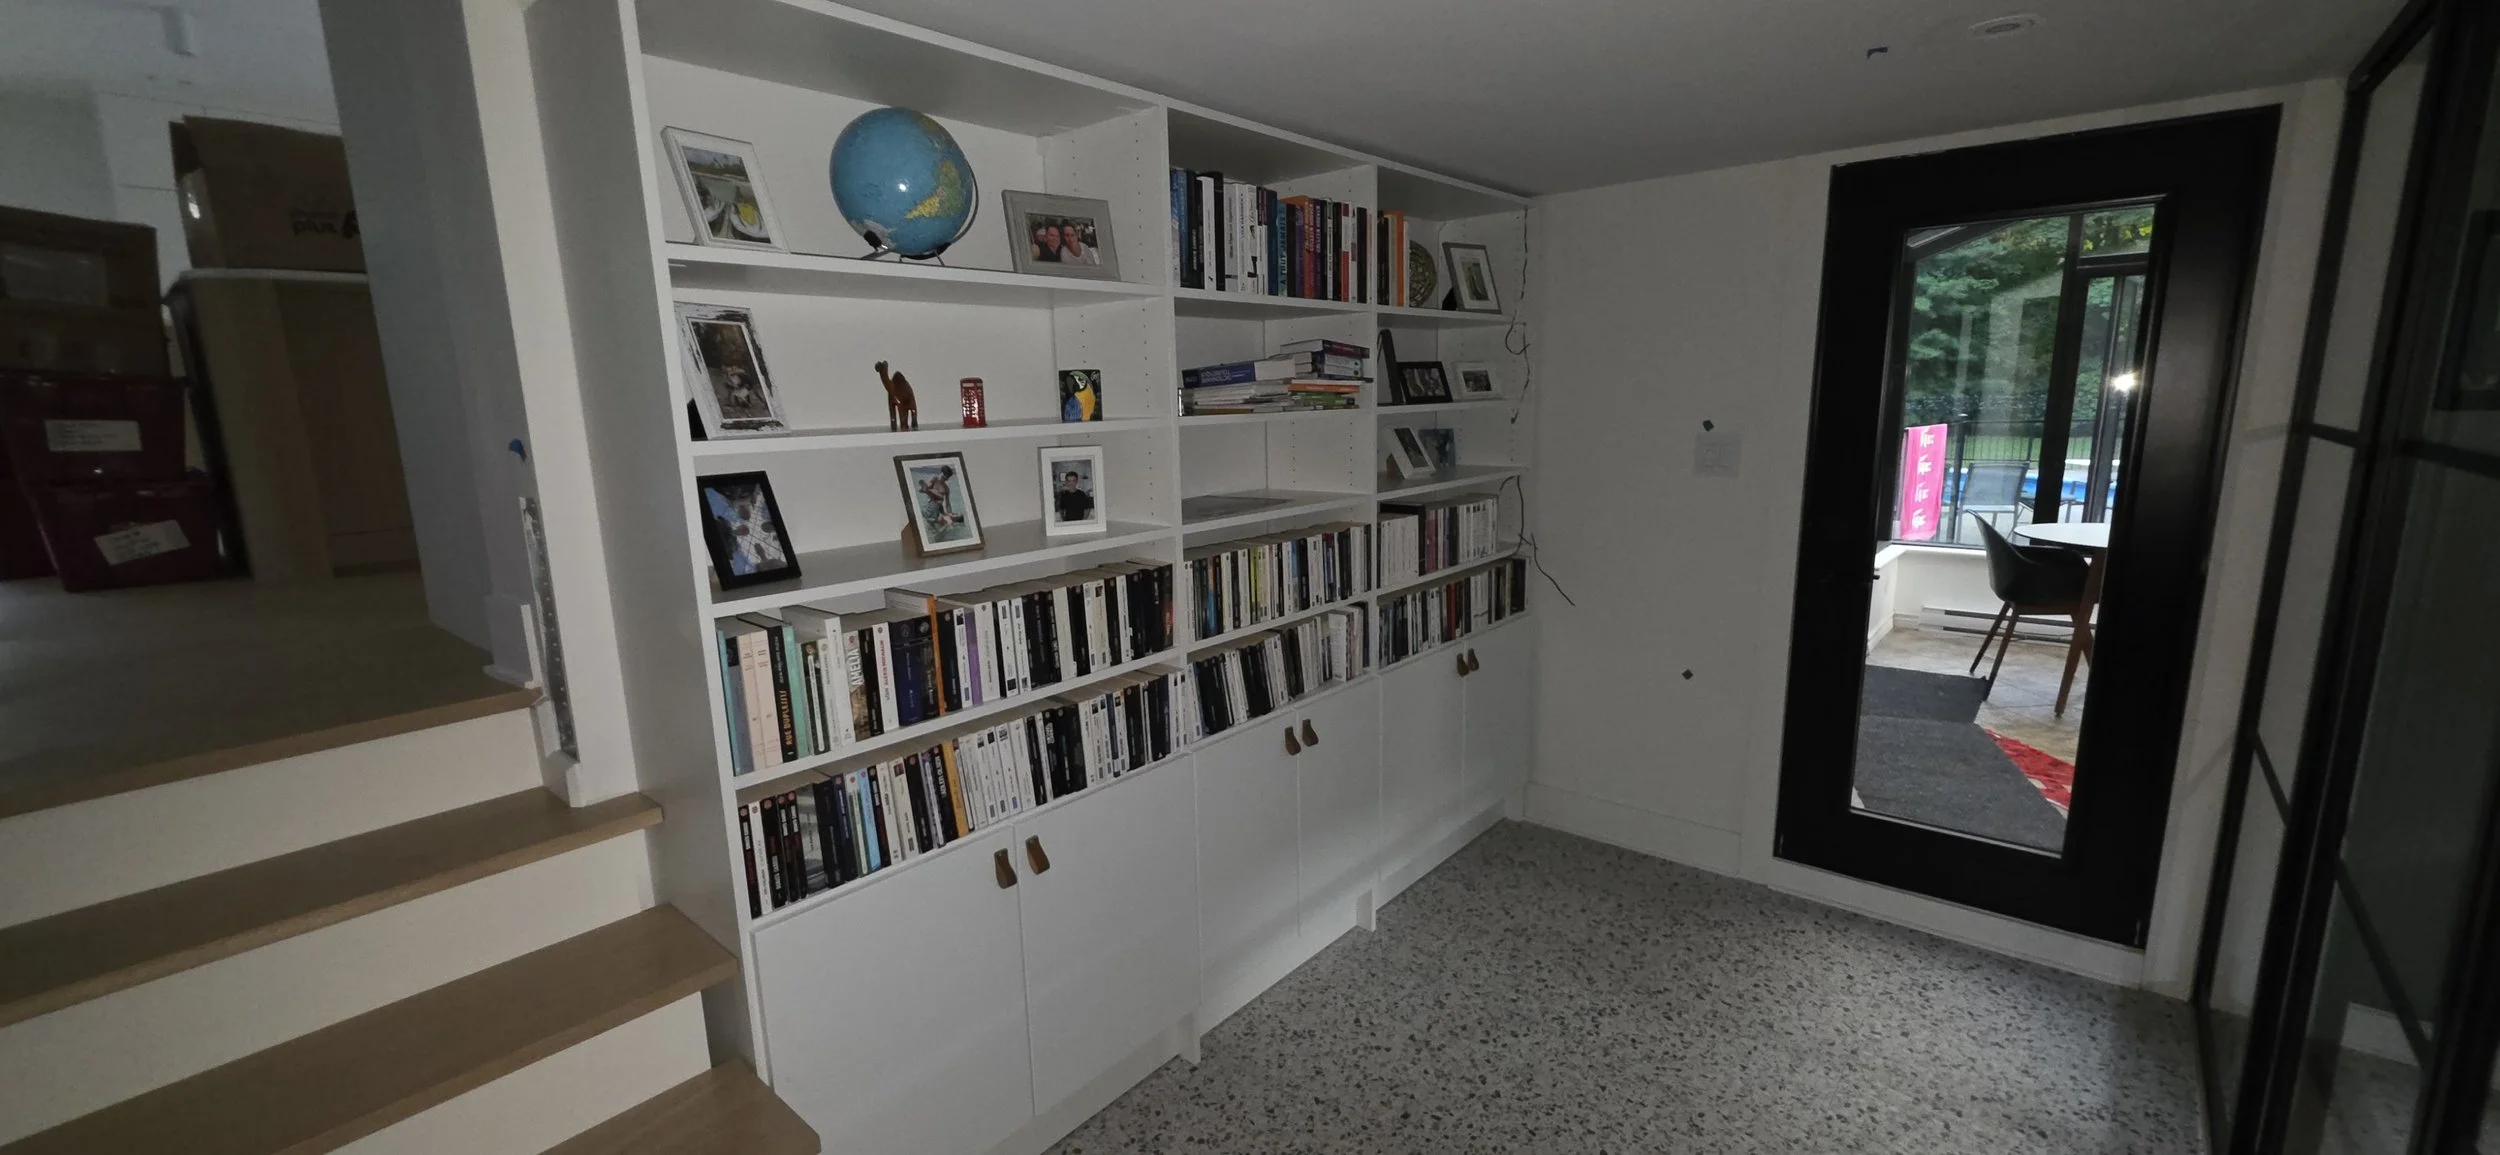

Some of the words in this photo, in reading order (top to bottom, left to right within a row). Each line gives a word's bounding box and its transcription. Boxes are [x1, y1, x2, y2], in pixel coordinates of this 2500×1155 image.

[847, 648, 865, 686] AMELIA
[779, 689, 791, 731] DUPLESSIS
[785, 731, 793, 746] RUE
